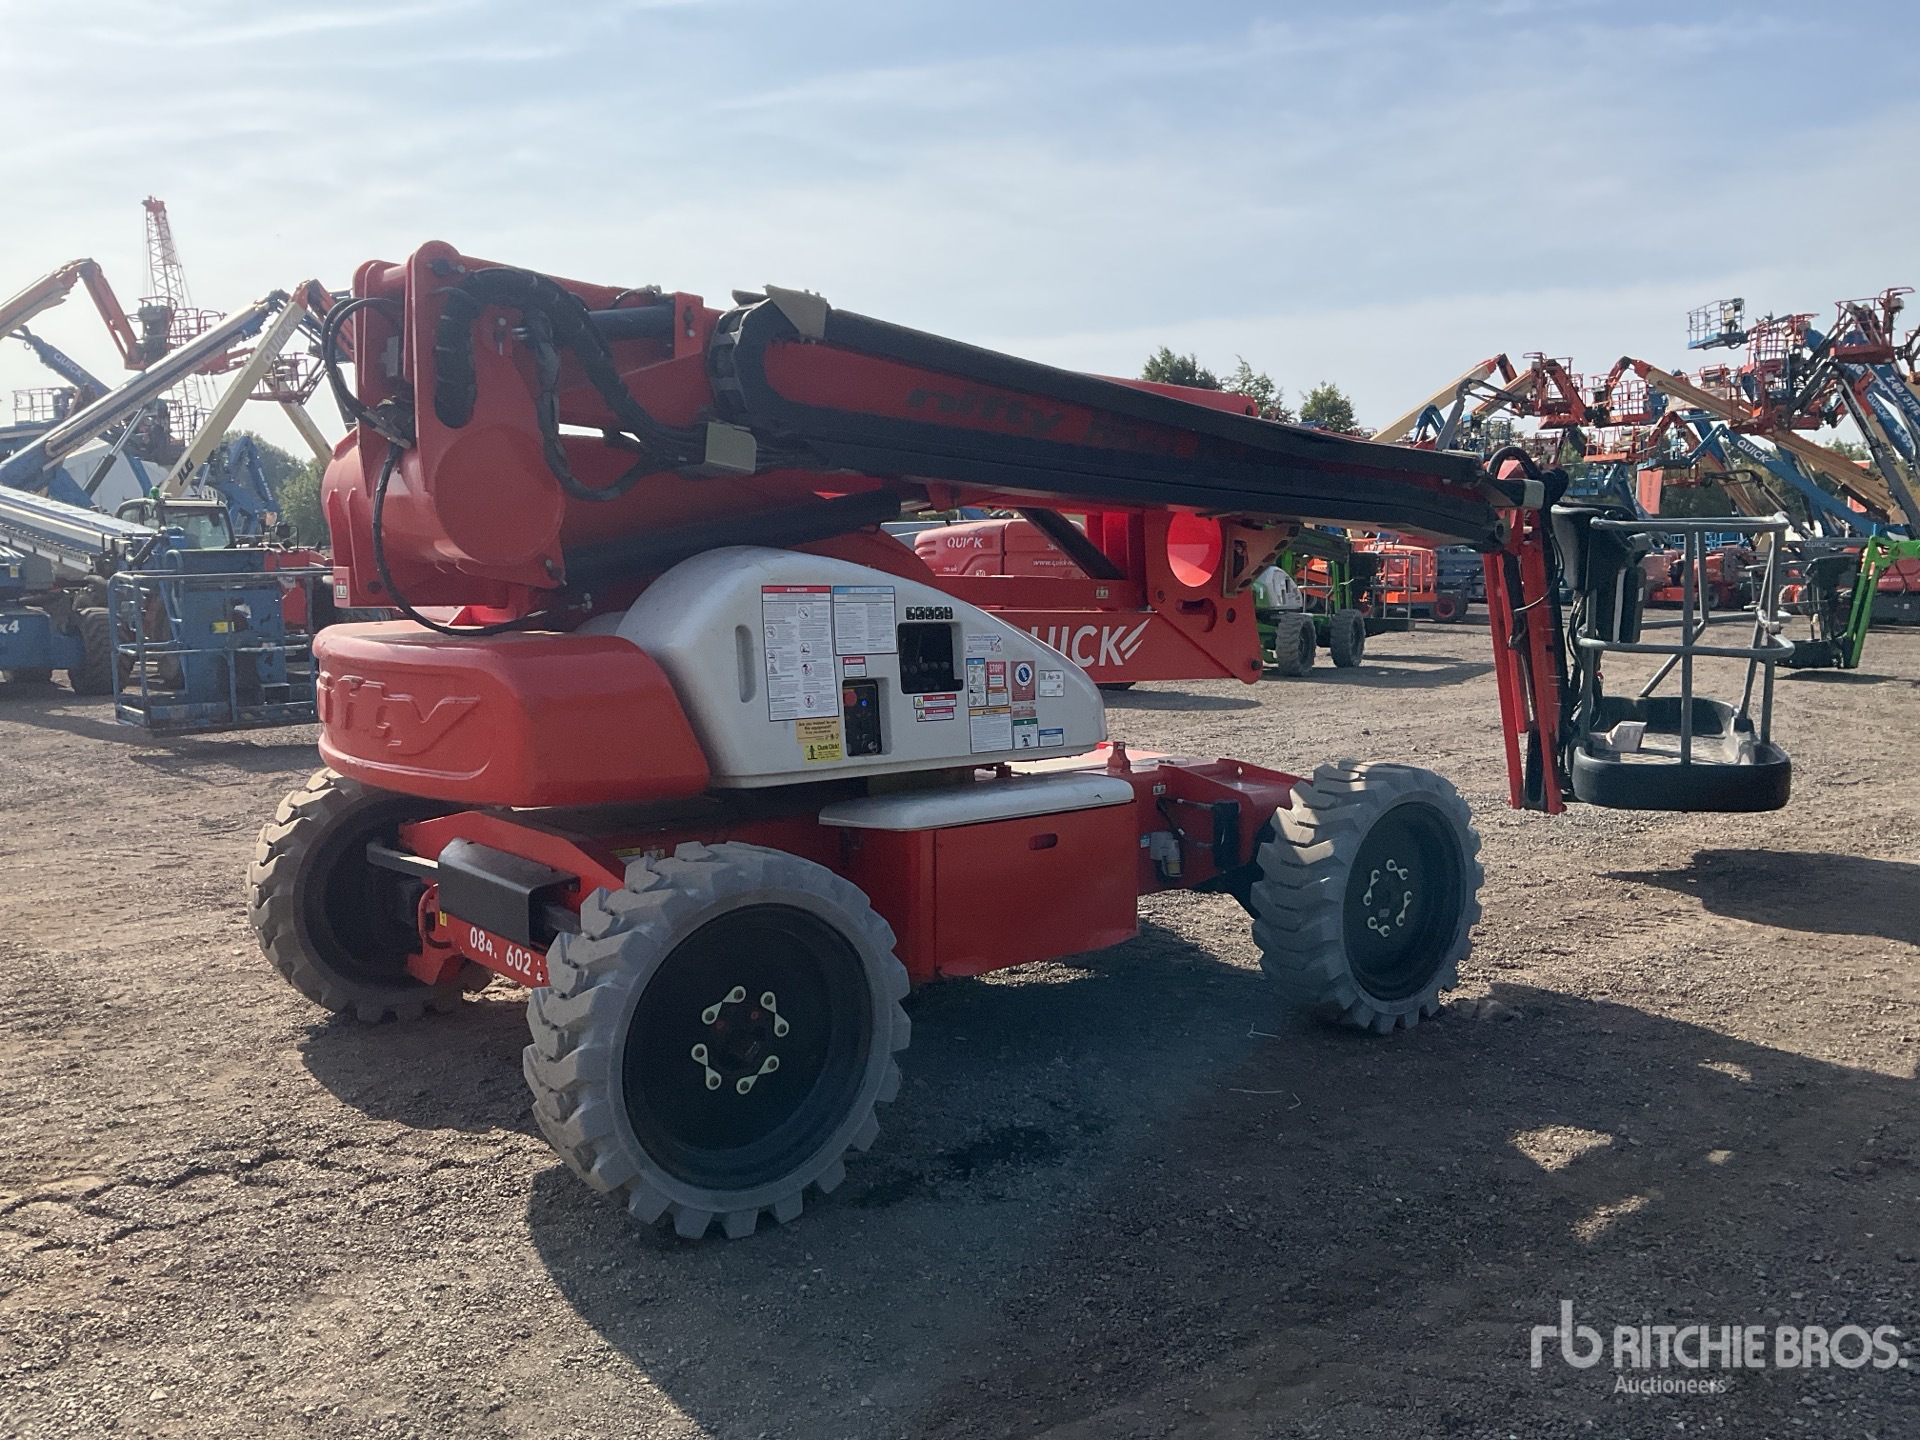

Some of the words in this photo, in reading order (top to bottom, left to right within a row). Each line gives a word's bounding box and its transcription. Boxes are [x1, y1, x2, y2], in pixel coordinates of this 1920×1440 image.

[53, 352, 85, 378] QUICK
[1866, 393, 1892, 420] QUICK
[1737, 439, 1770, 463] QUICK
[177, 457, 195, 487] JLG
[0, 619, 20, 634] x4
[989, 663, 1004, 673] STOP!
[316, 671, 481, 757] ifty
[506, 945, 531, 976] 602
